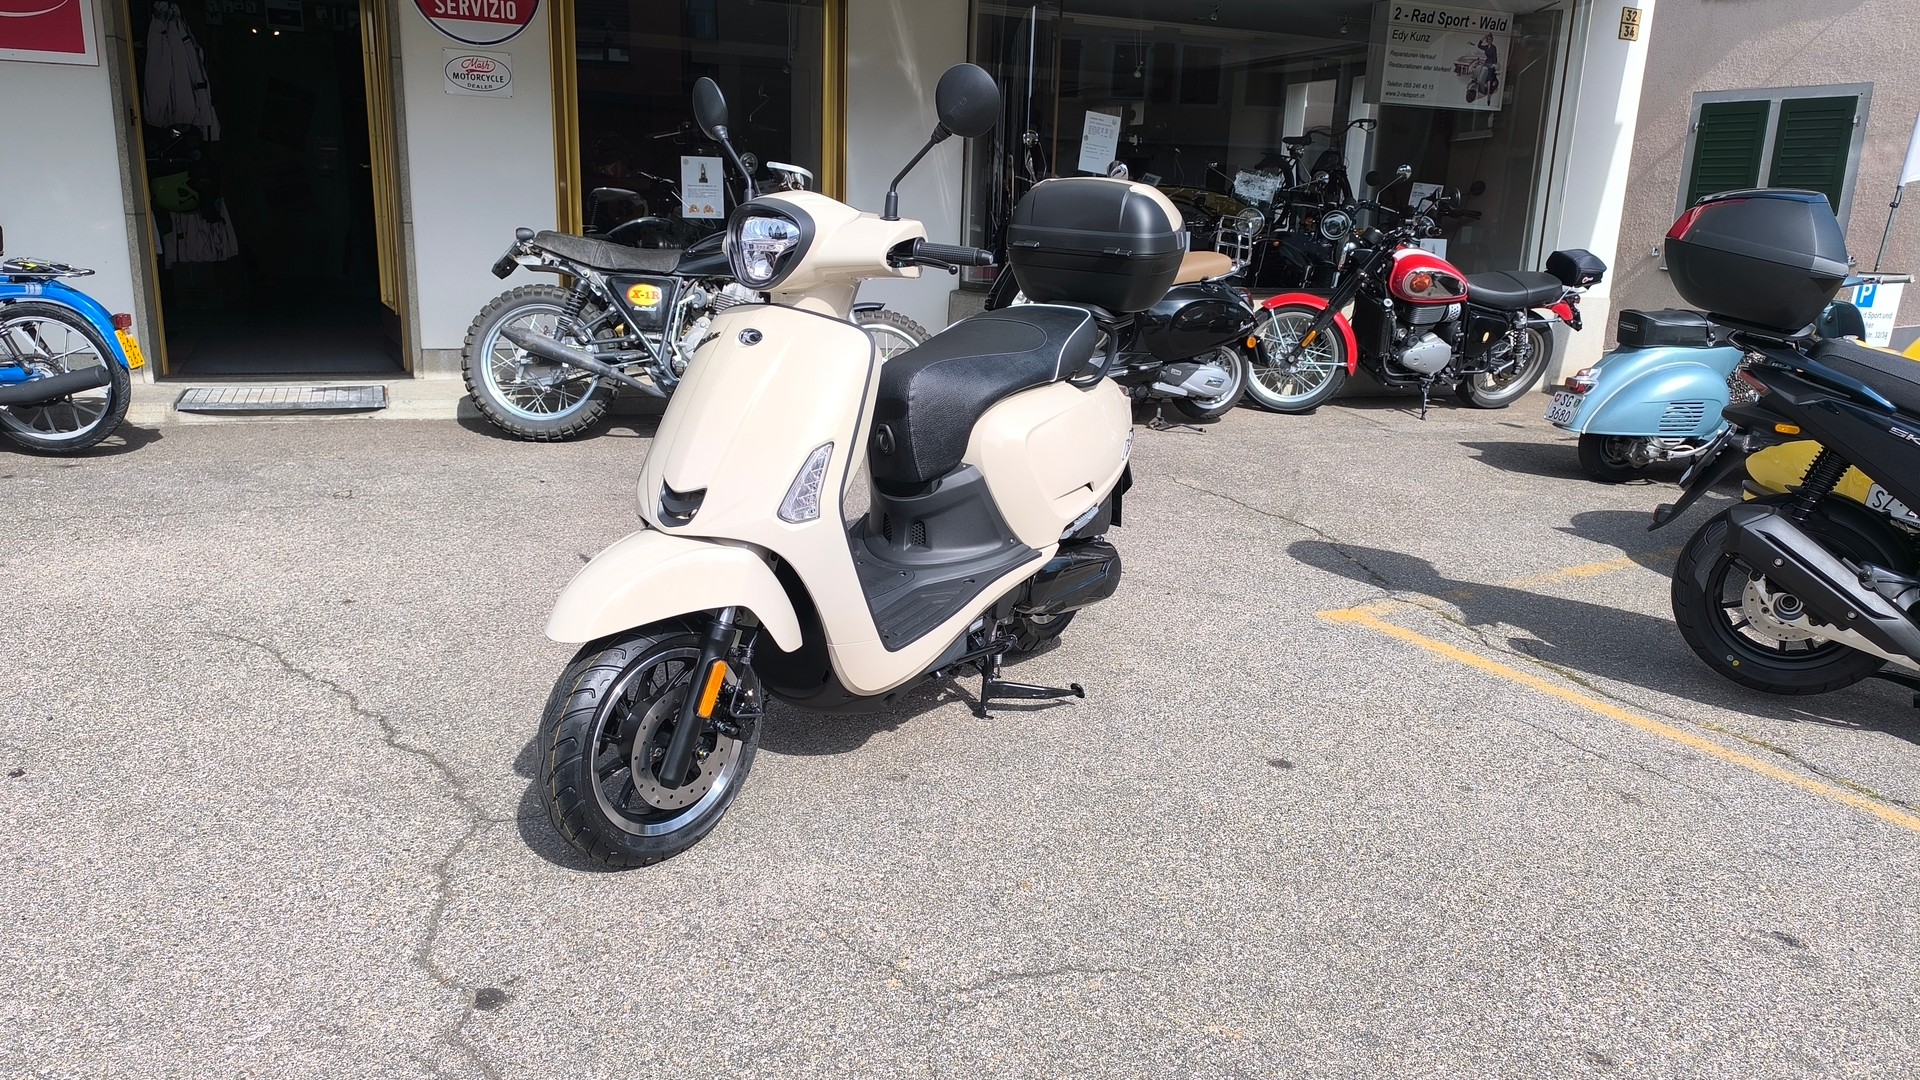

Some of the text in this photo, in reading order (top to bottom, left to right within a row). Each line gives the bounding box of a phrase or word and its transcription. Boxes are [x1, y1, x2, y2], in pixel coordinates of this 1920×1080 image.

[435, 0, 517, 20] SERVIZIO
[1626, 10, 1638, 22] 32
[1394, 7, 1402, 20] 2
[1411, 9, 1435, 24] Rad
[1437, 12, 1470, 28] Sport
[1480, 16, 1508, 31] Wald
[1392, 29, 1431, 43] Edy Kunz
[1624, 26, 1635, 38] 34
[461, 58, 495, 73] Mash
[452, 72, 504, 83] MOTORCYCLE
[631, 290, 660, 300] X-1R
[1859, 284, 1873, 303] P
[1561, 394, 1574, 407] SG
[1549, 407, 1571, 422] 3680
